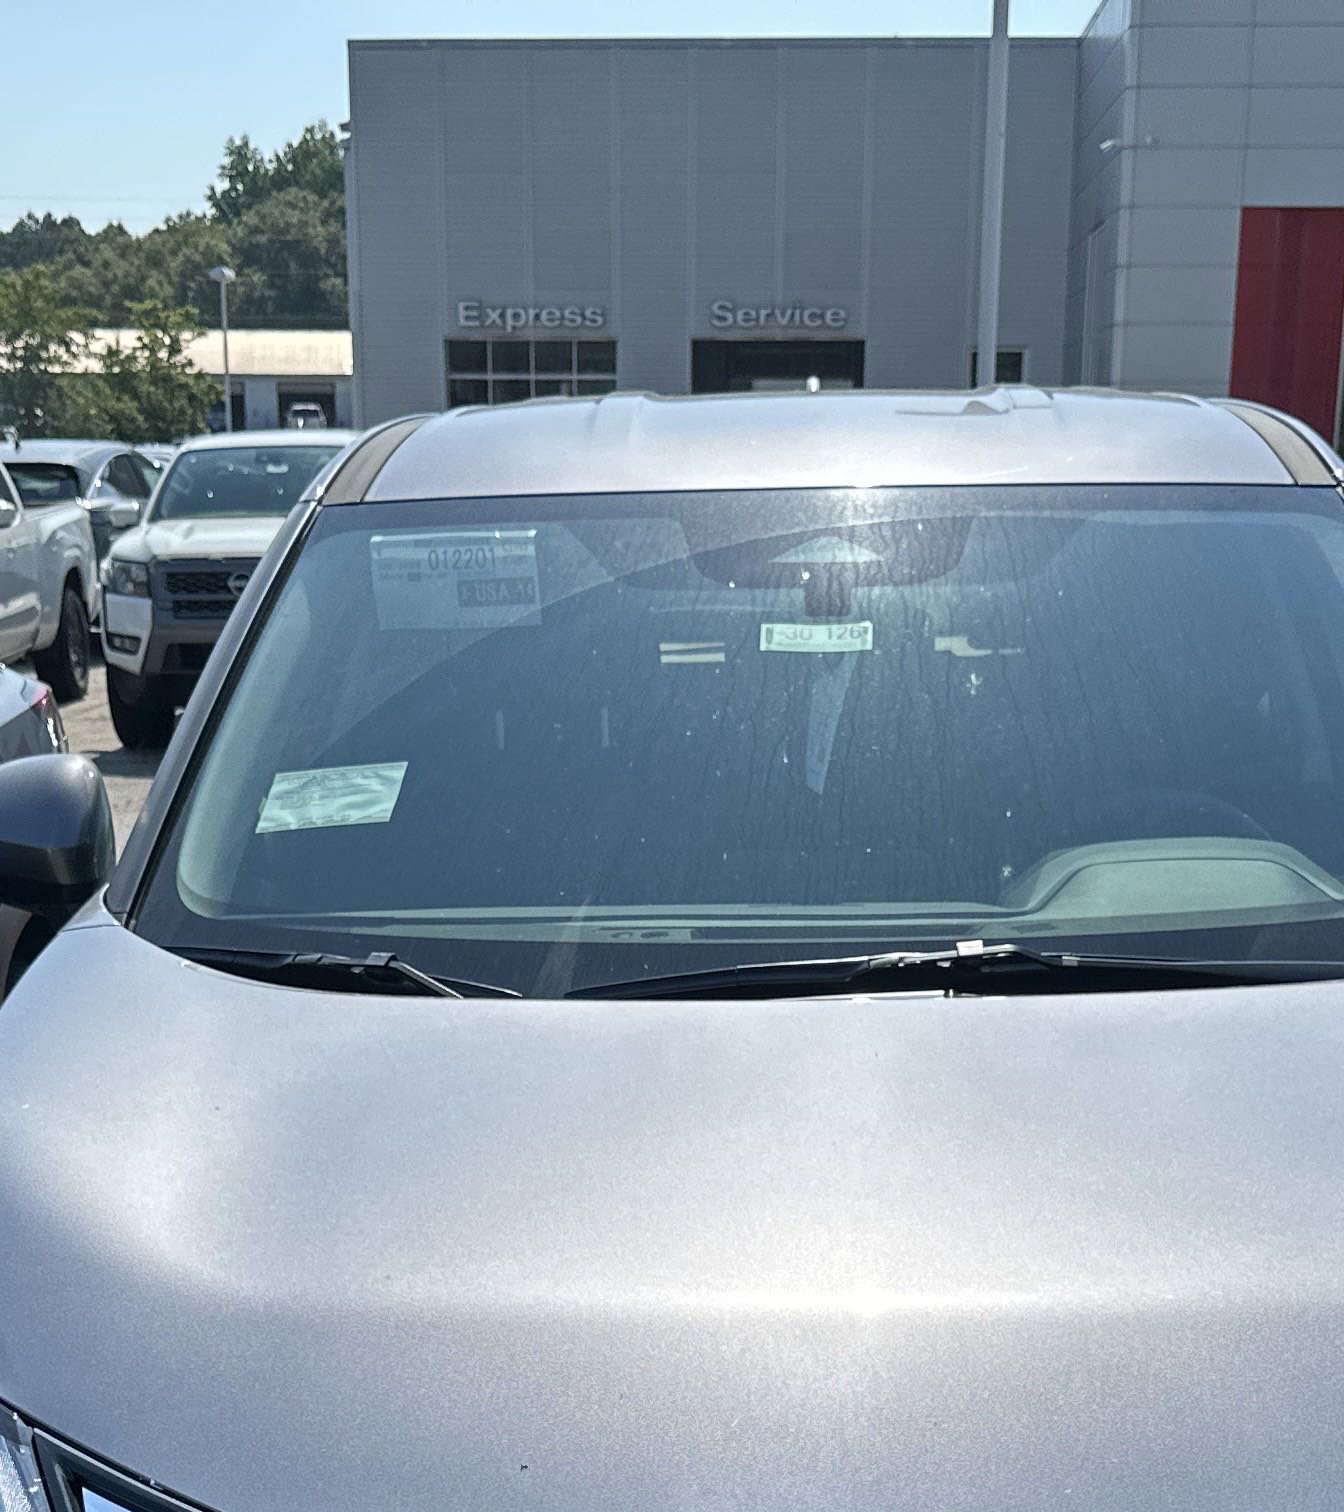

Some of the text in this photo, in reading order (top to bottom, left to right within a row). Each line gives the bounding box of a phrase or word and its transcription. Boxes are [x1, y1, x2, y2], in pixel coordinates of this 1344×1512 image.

[457, 301, 605, 332] Express
[711, 301, 846, 328] Service
[427, 547, 498, 571] 012201
